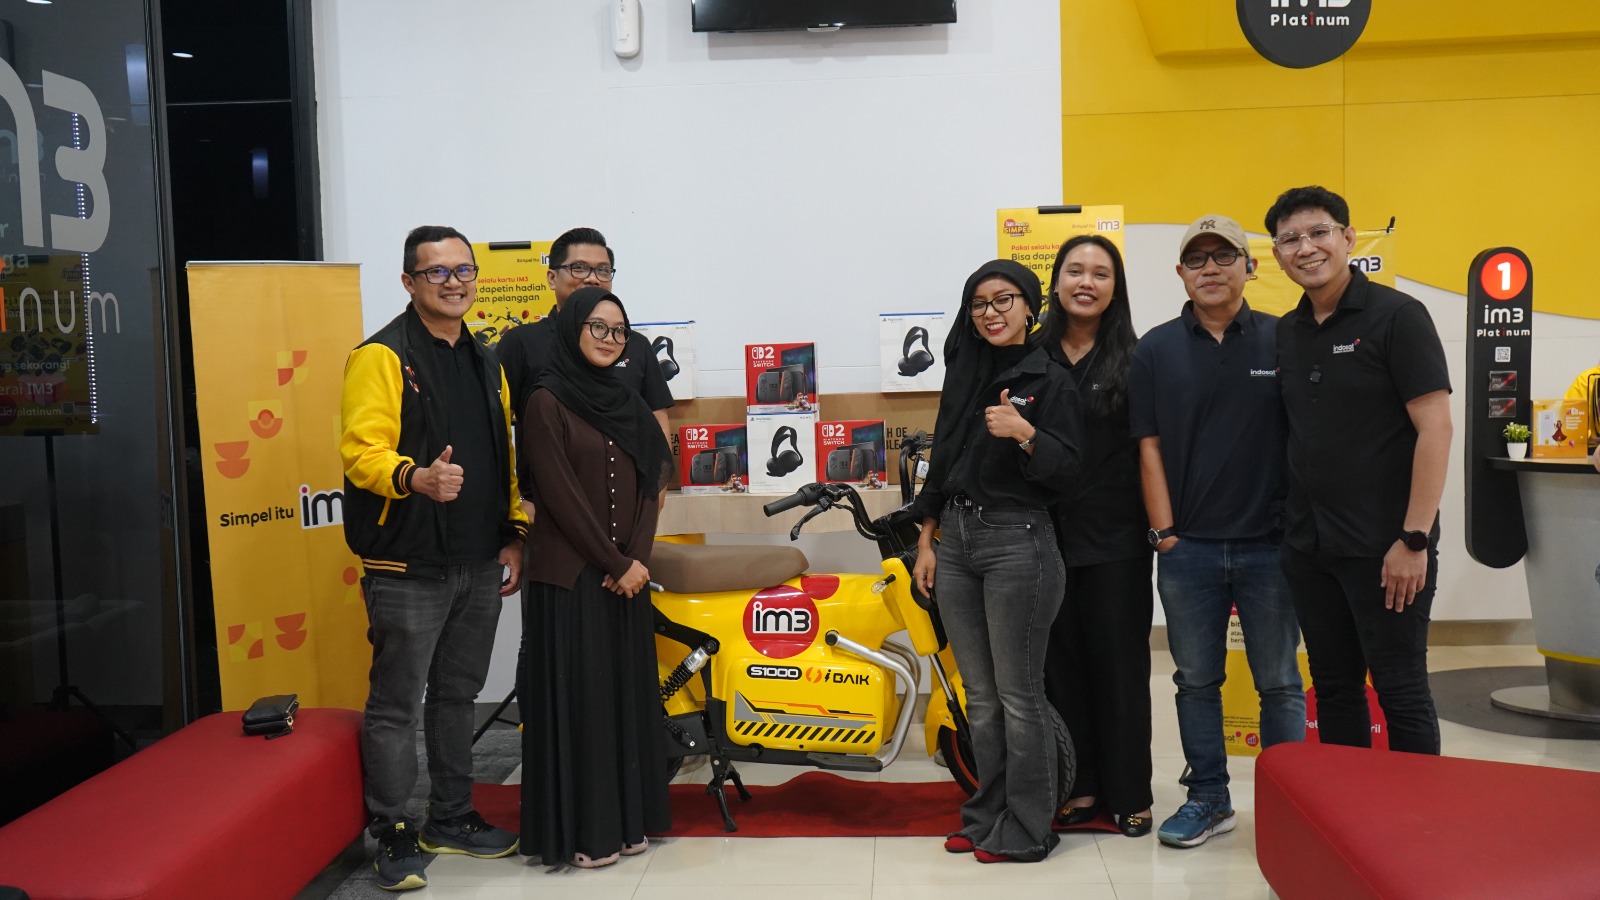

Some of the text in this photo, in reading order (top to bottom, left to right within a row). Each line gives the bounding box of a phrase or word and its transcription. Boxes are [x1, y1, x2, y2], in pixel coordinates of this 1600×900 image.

[1270, 12, 1350, 26] Platinum
[1097, 219, 1120, 231] im3
[1011, 253, 1031, 261] Bisa
[1497, 261, 1511, 291] 1
[479, 283, 547, 295] dapetin hadiah
[491, 293, 540, 304] pelanggan
[1483, 304, 1524, 324] im3
[1476, 328, 1531, 337] Platinum
[27, 382, 54, 395] IM3
[219, 507, 272, 528] Simpel
[275, 506, 294, 520] itu
[755, 602, 810, 632] im3
[750, 666, 799, 678] S1000
